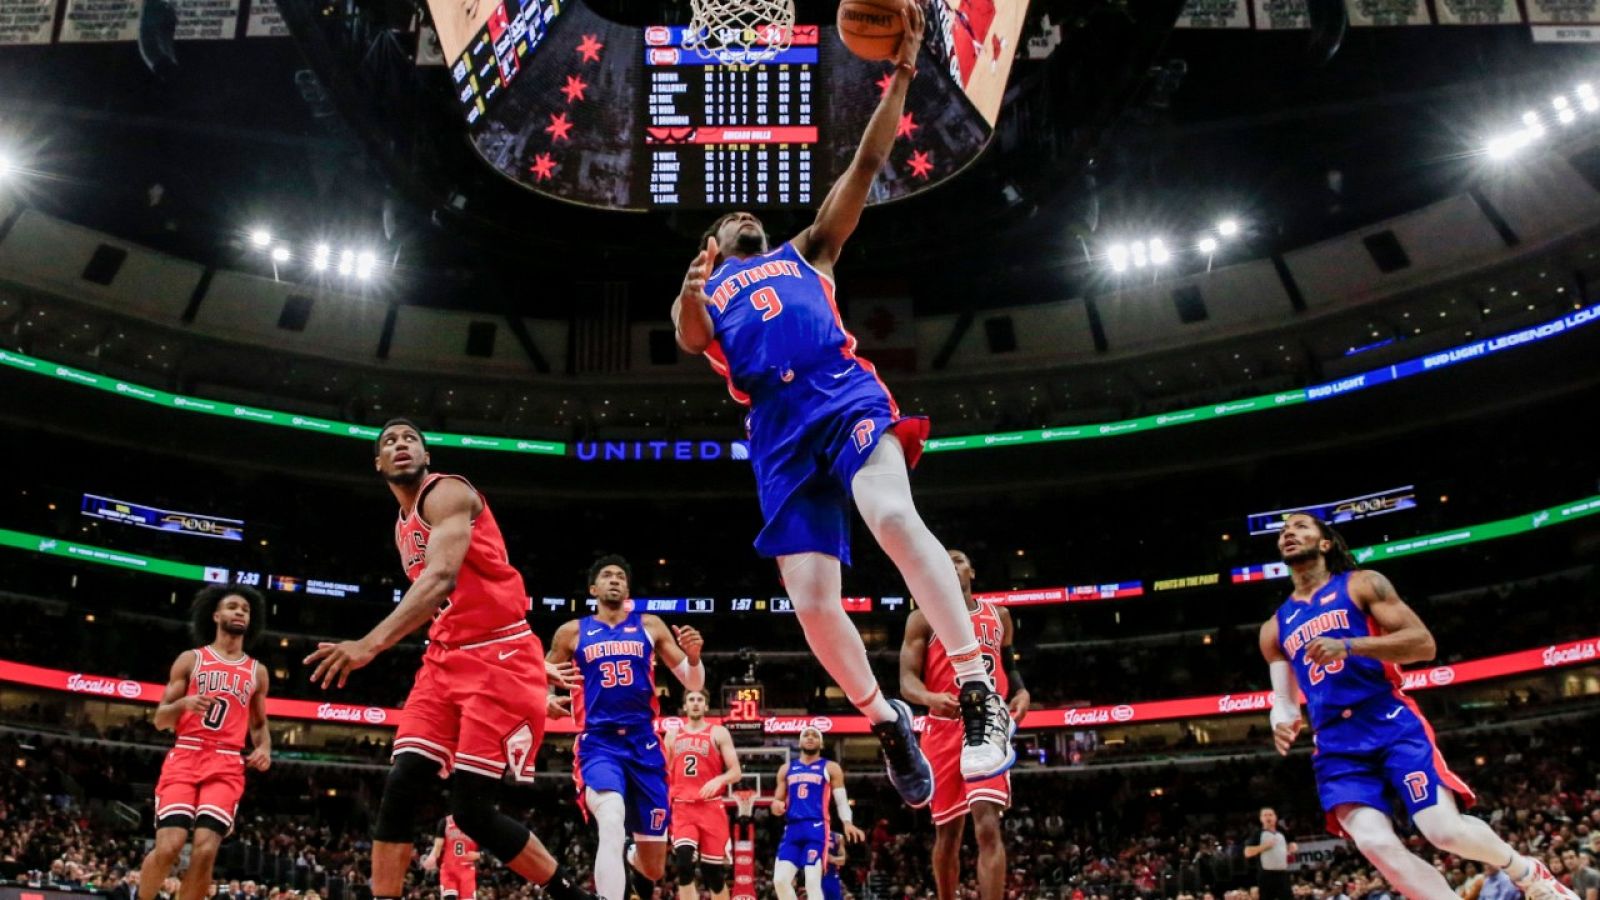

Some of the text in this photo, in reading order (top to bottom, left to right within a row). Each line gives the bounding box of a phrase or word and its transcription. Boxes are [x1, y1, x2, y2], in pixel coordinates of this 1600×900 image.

[711, 259, 802, 314] DETROIT
[750, 286, 783, 321] 9
[1424, 353, 1449, 368] BUD
[1450, 343, 1486, 361] LIGHT
[1488, 320, 1566, 351] LEGENDS
[1308, 386, 1332, 398] BUD
[1333, 376, 1365, 393] LIGHT
[577, 442, 721, 460] UNITED
[646, 600, 682, 610] DETROIT
[1007, 592, 1045, 602] CHAMPIONS
[1045, 591, 1061, 600] CLUB
[1283, 609, 1350, 660] DETROIT
[583, 640, 645, 663] DETROIT
[599, 660, 634, 688] 35
[198, 670, 251, 708] BULLS
[738, 689, 760, 701] 1:57
[202, 696, 230, 731] 0
[730, 700, 757, 721] 20
[684, 755, 698, 776] 2
[797, 783, 808, 799] 6
[454, 840, 465, 856] 8
